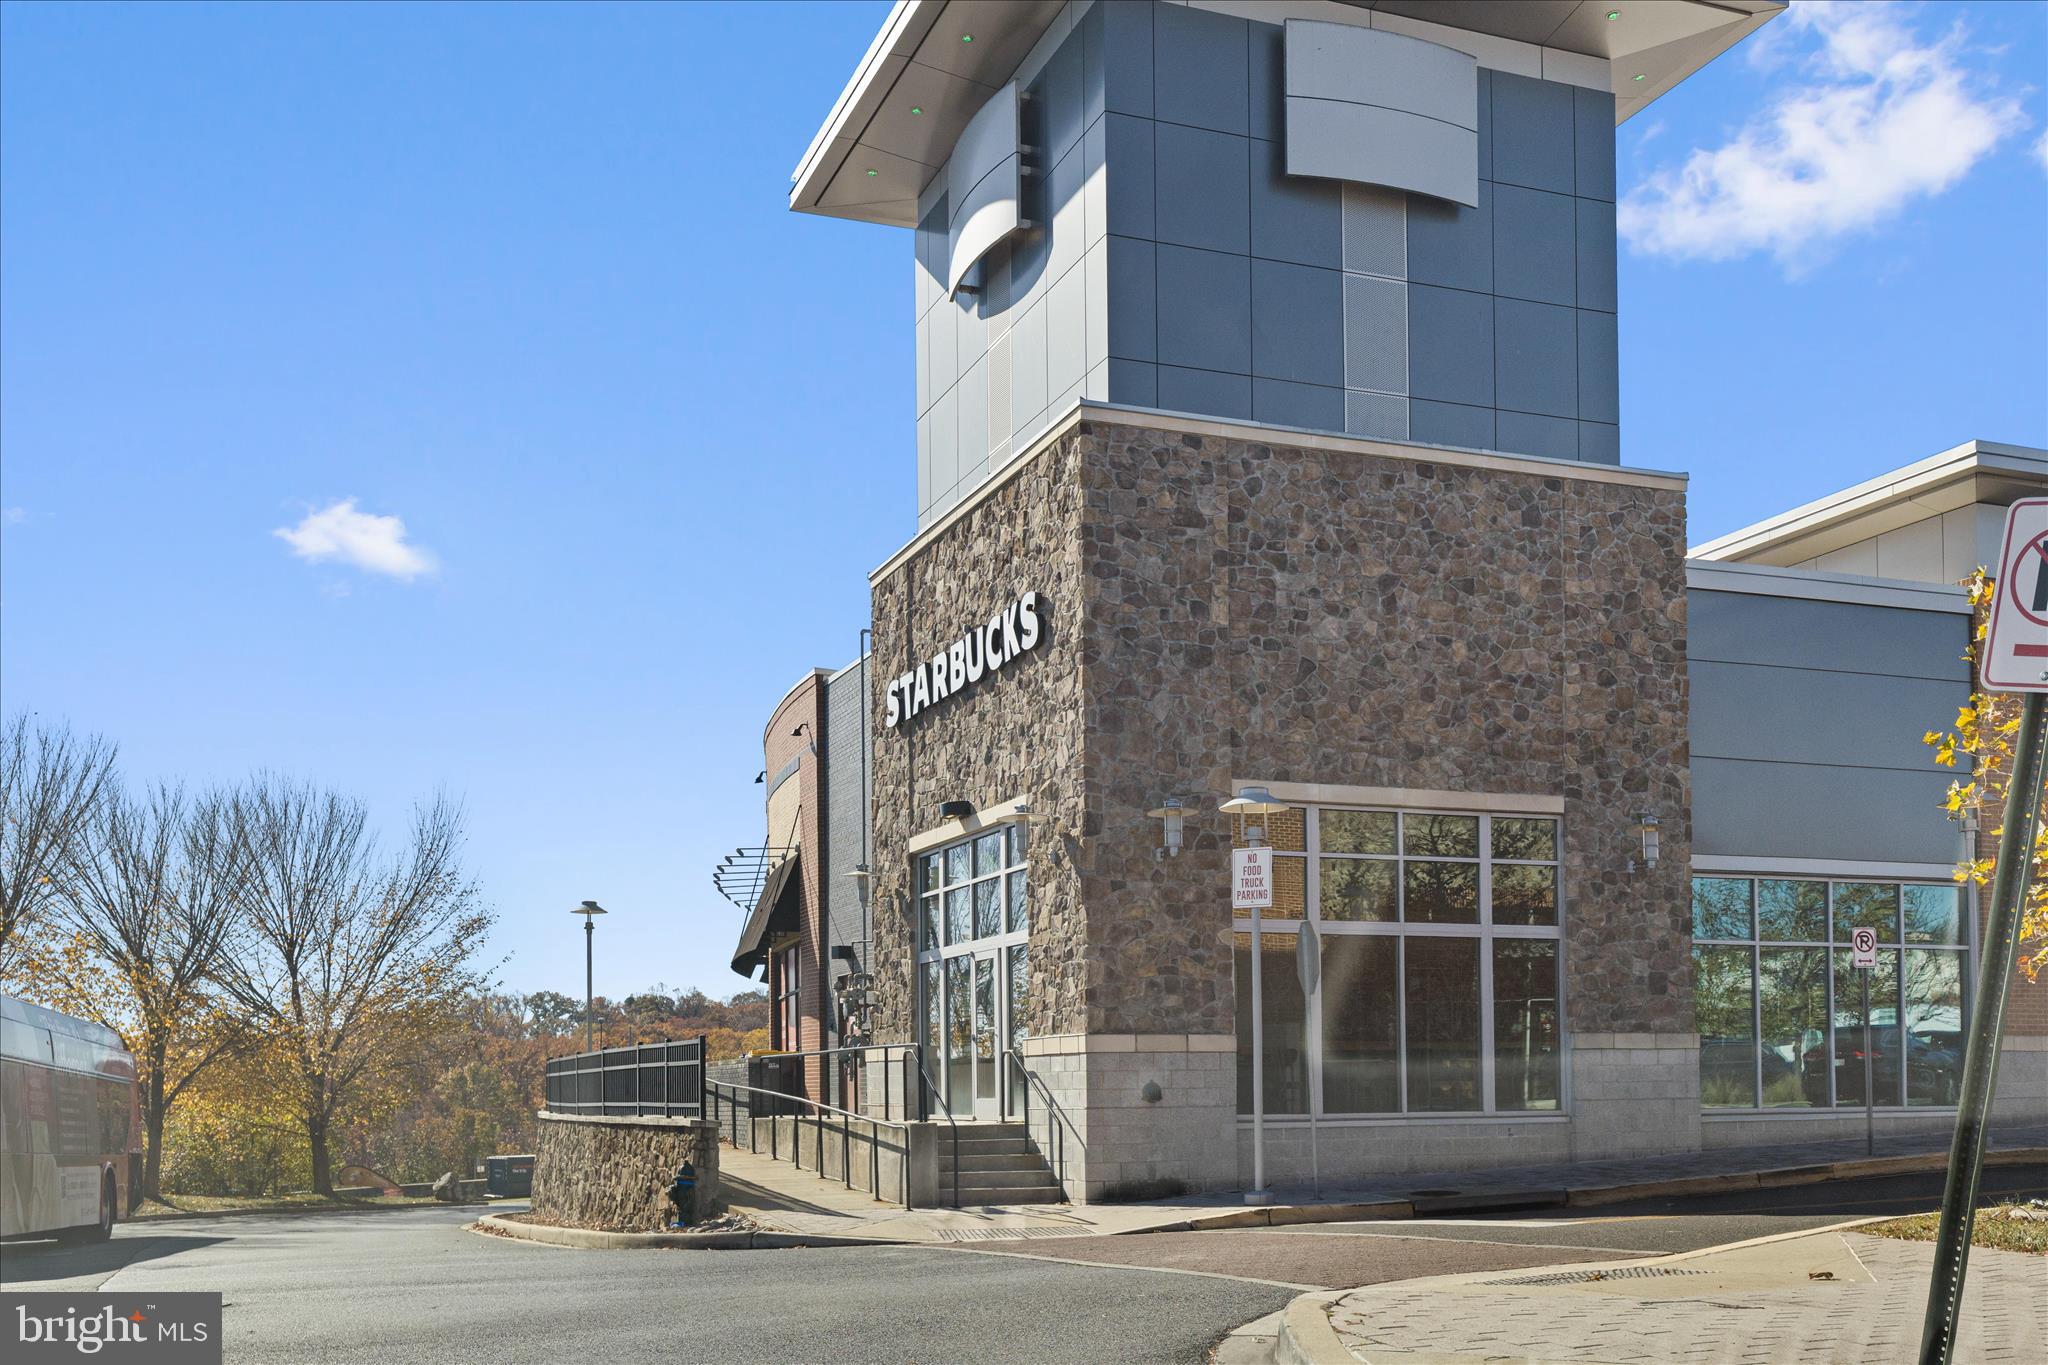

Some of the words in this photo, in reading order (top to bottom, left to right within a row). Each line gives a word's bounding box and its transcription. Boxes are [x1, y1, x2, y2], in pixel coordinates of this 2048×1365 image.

[886, 591, 1040, 728] STARBUCKS
[1247, 853, 1257, 863] NO
[1242, 865, 1262, 876] FOOD
[1240, 877, 1264, 889] TRUCK
[1236, 889, 1268, 900] PARKING
